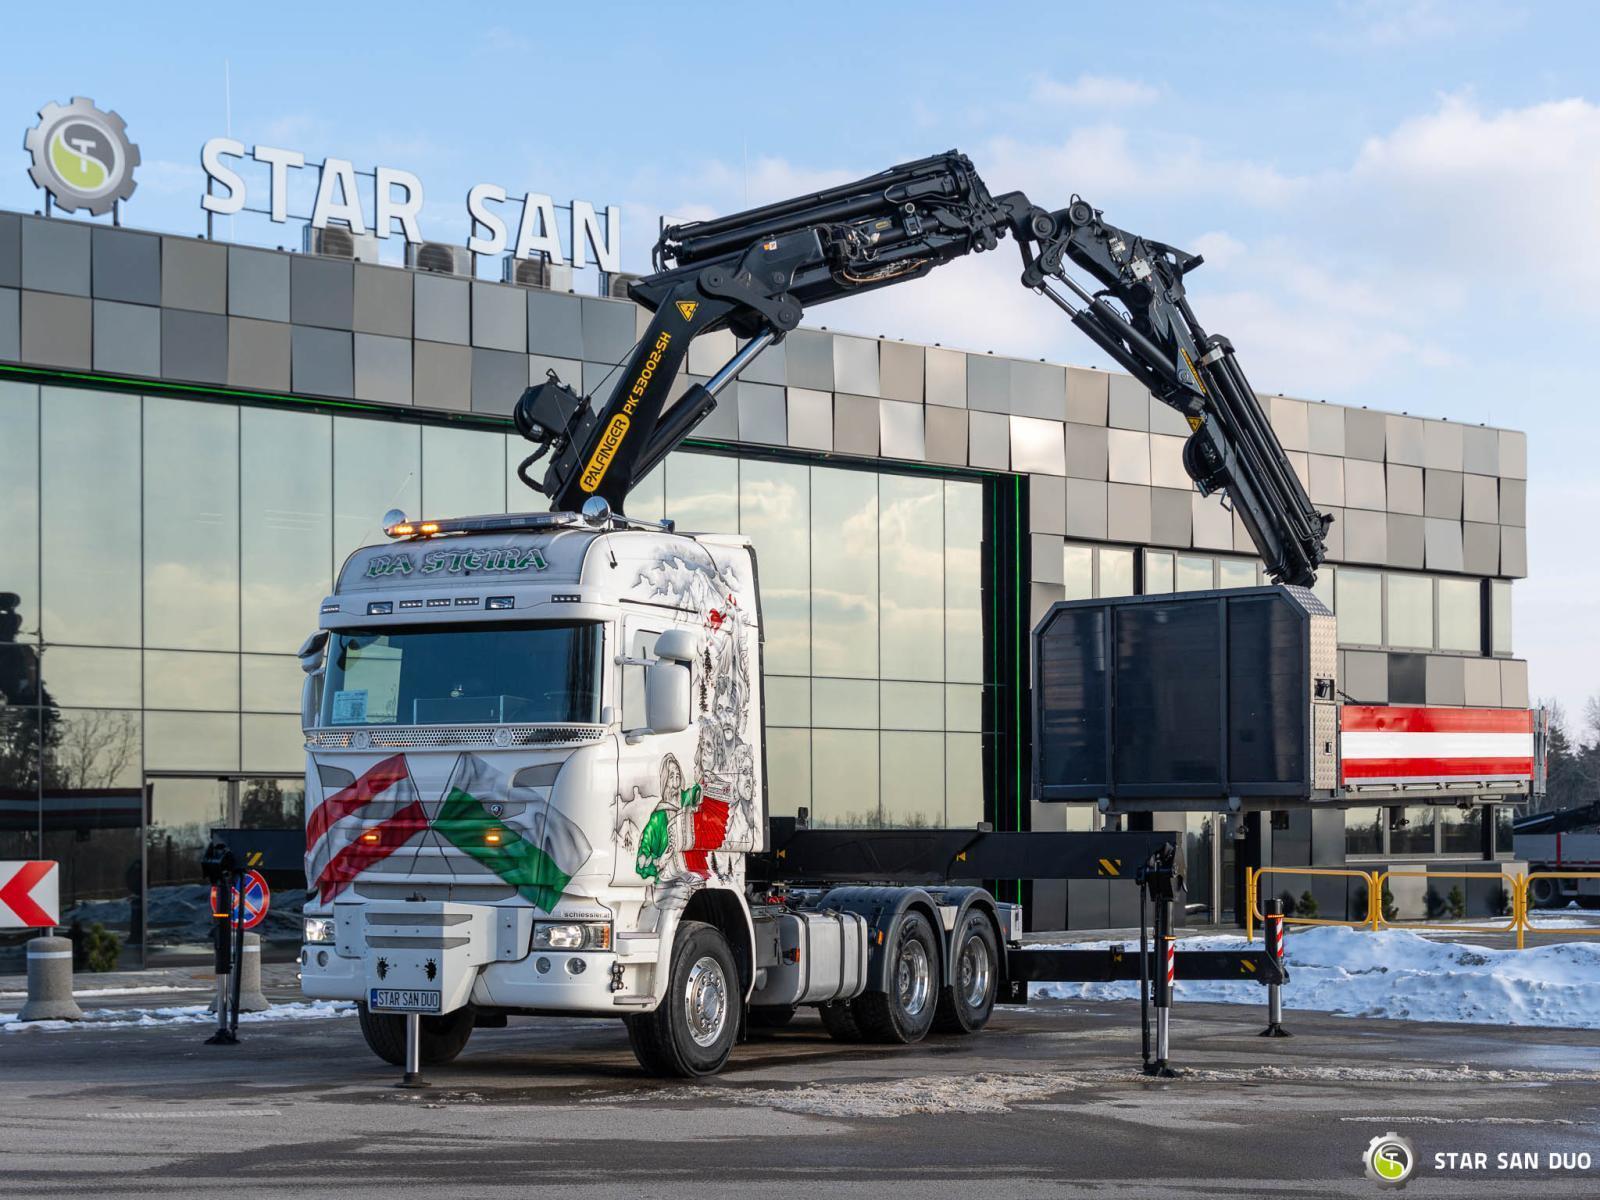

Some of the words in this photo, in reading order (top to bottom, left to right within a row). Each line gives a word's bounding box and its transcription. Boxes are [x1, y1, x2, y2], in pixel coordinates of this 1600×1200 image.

[201, 138, 424, 244] STAR
[467, 183, 620, 273] SAN
[583, 418, 627, 488] PALFINGER
[622, 394, 640, 416] PK
[632, 331, 673, 397] 53002-SH
[366, 554, 414, 579] DA
[378, 991, 400, 1006] STAR
[402, 992, 419, 1007] SAN
[421, 992, 439, 1007] DUO
